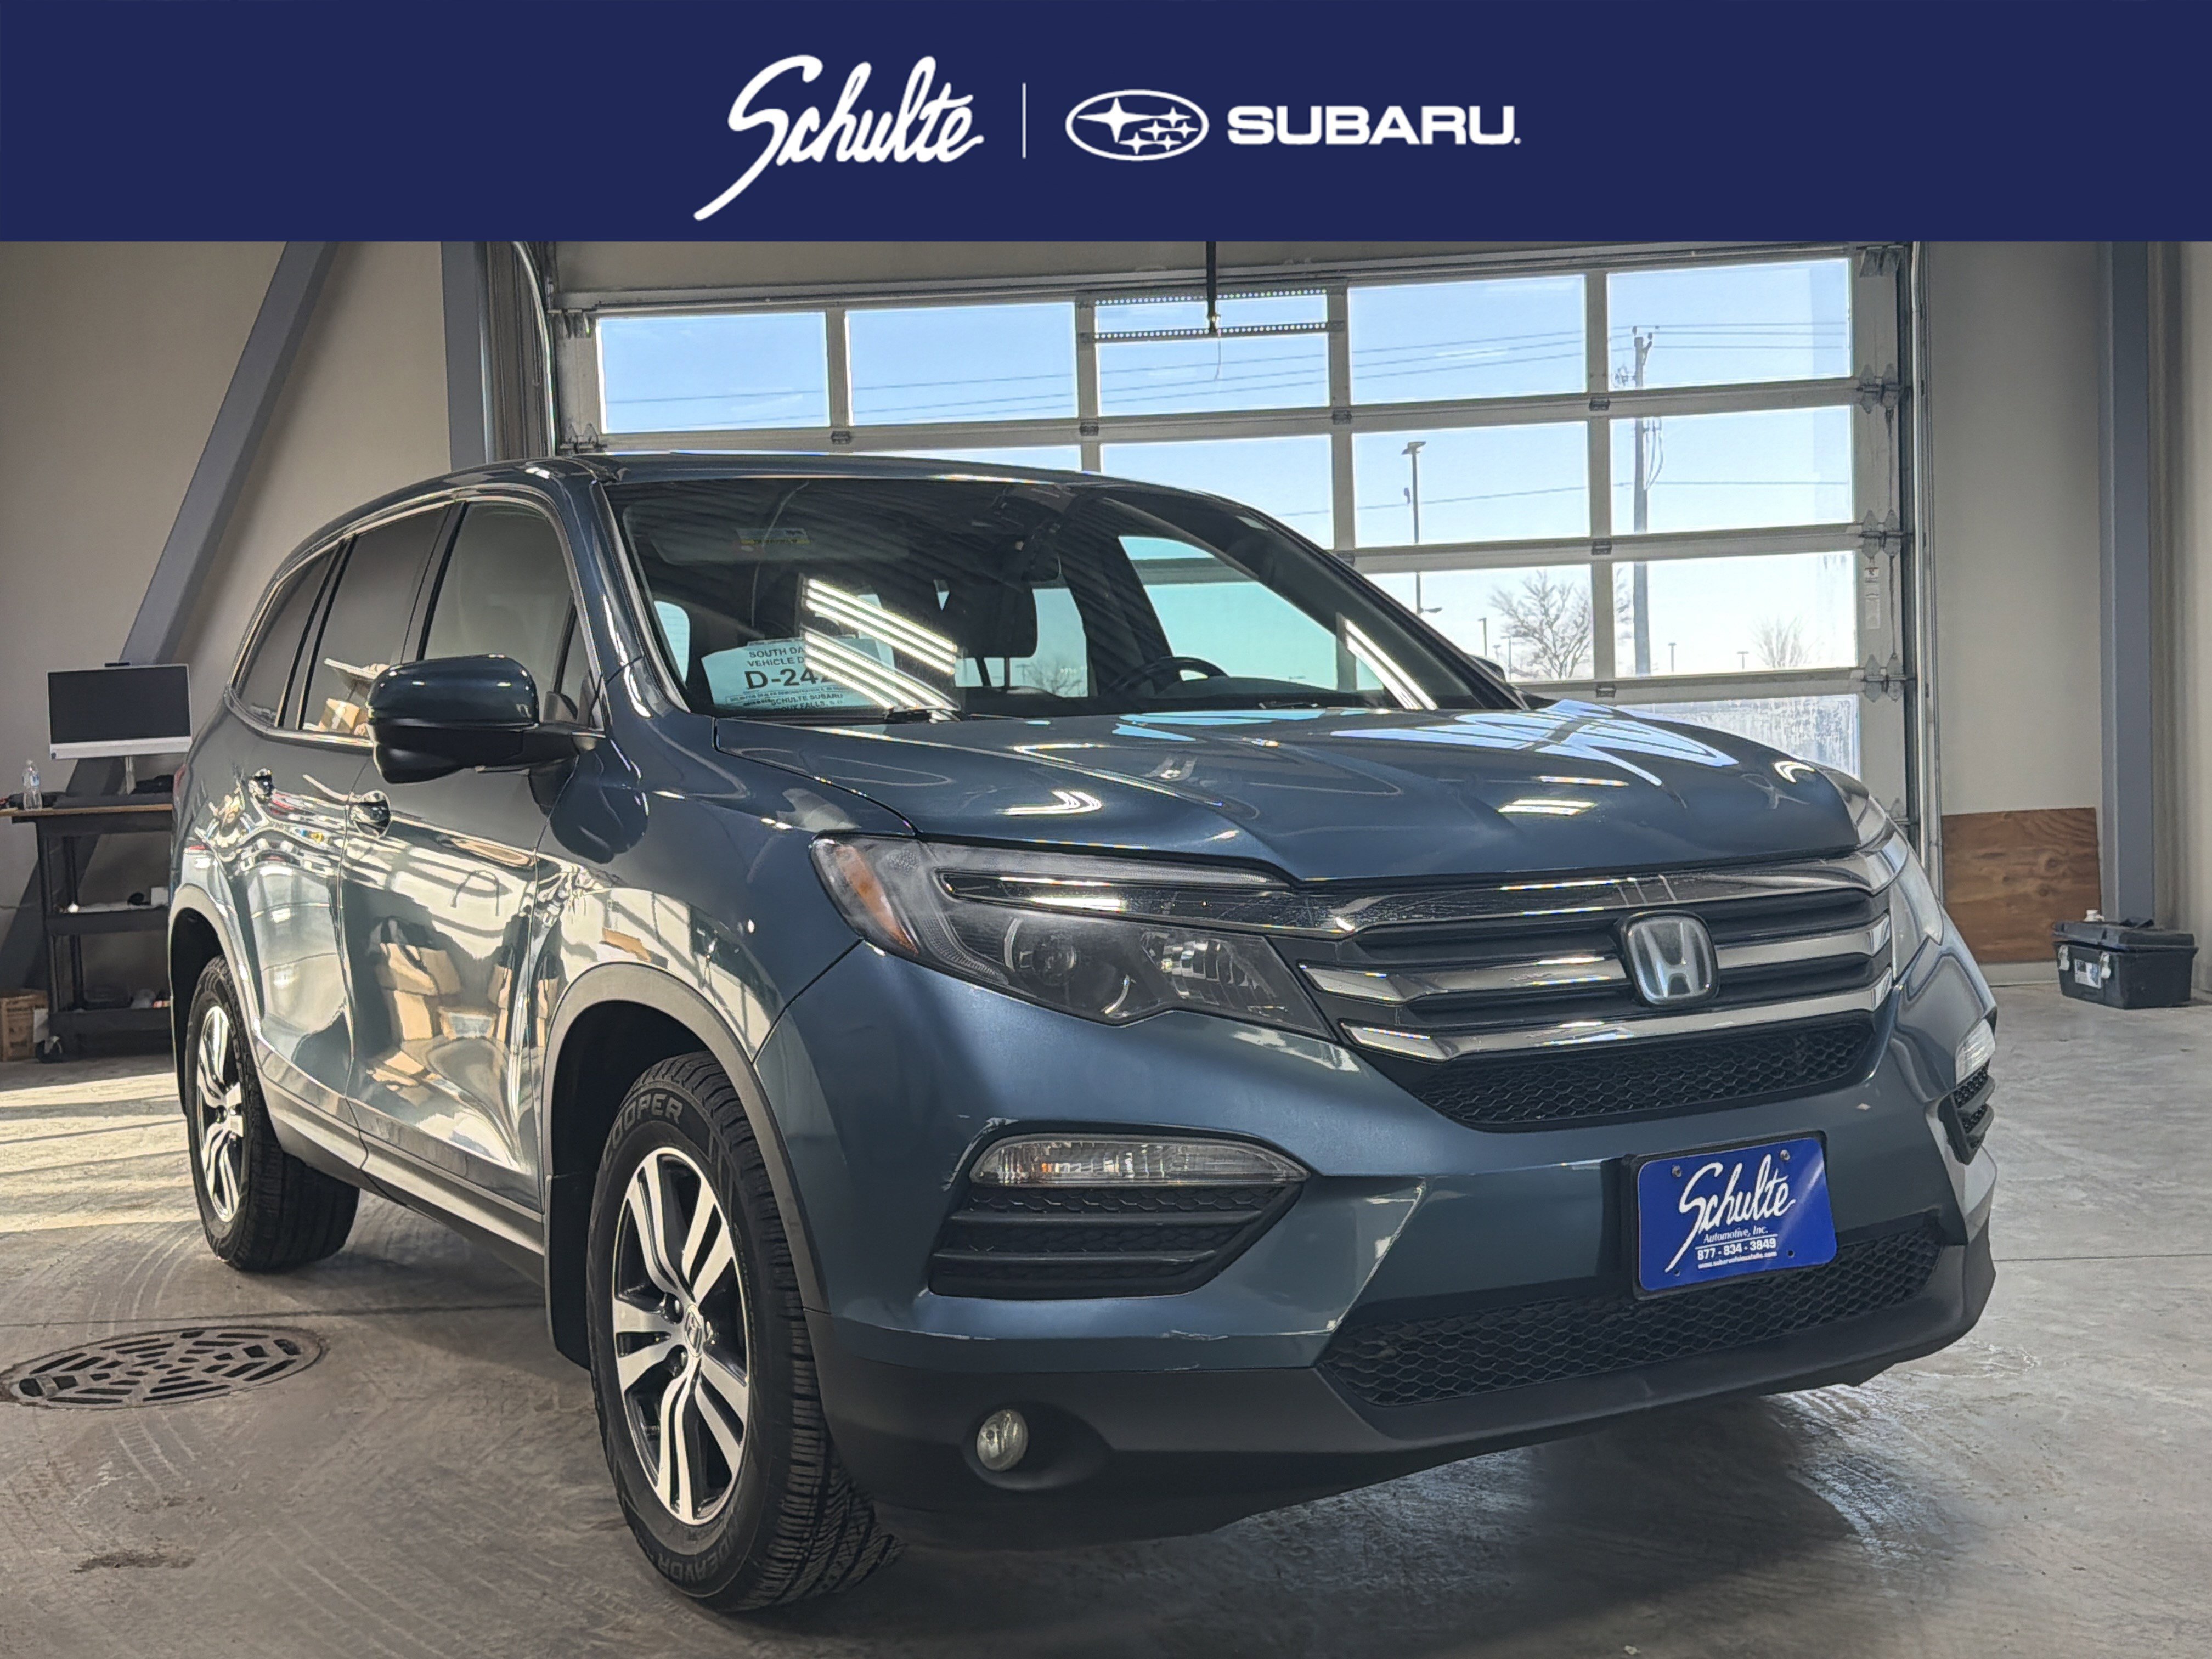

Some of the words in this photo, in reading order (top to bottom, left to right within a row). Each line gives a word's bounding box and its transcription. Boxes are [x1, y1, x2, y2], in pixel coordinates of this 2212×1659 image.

[749, 647, 787, 658] SOUTH
[747, 657, 795, 667] VEHICLE
[771, 695, 808, 706] SCHULTE
[601, 1093, 684, 1172] COOPER
[1665, 1154, 1796, 1273] Schulte
[1703, 1228, 1751, 1243] Automotive,
[1753, 1225, 1769, 1237] Inc.
